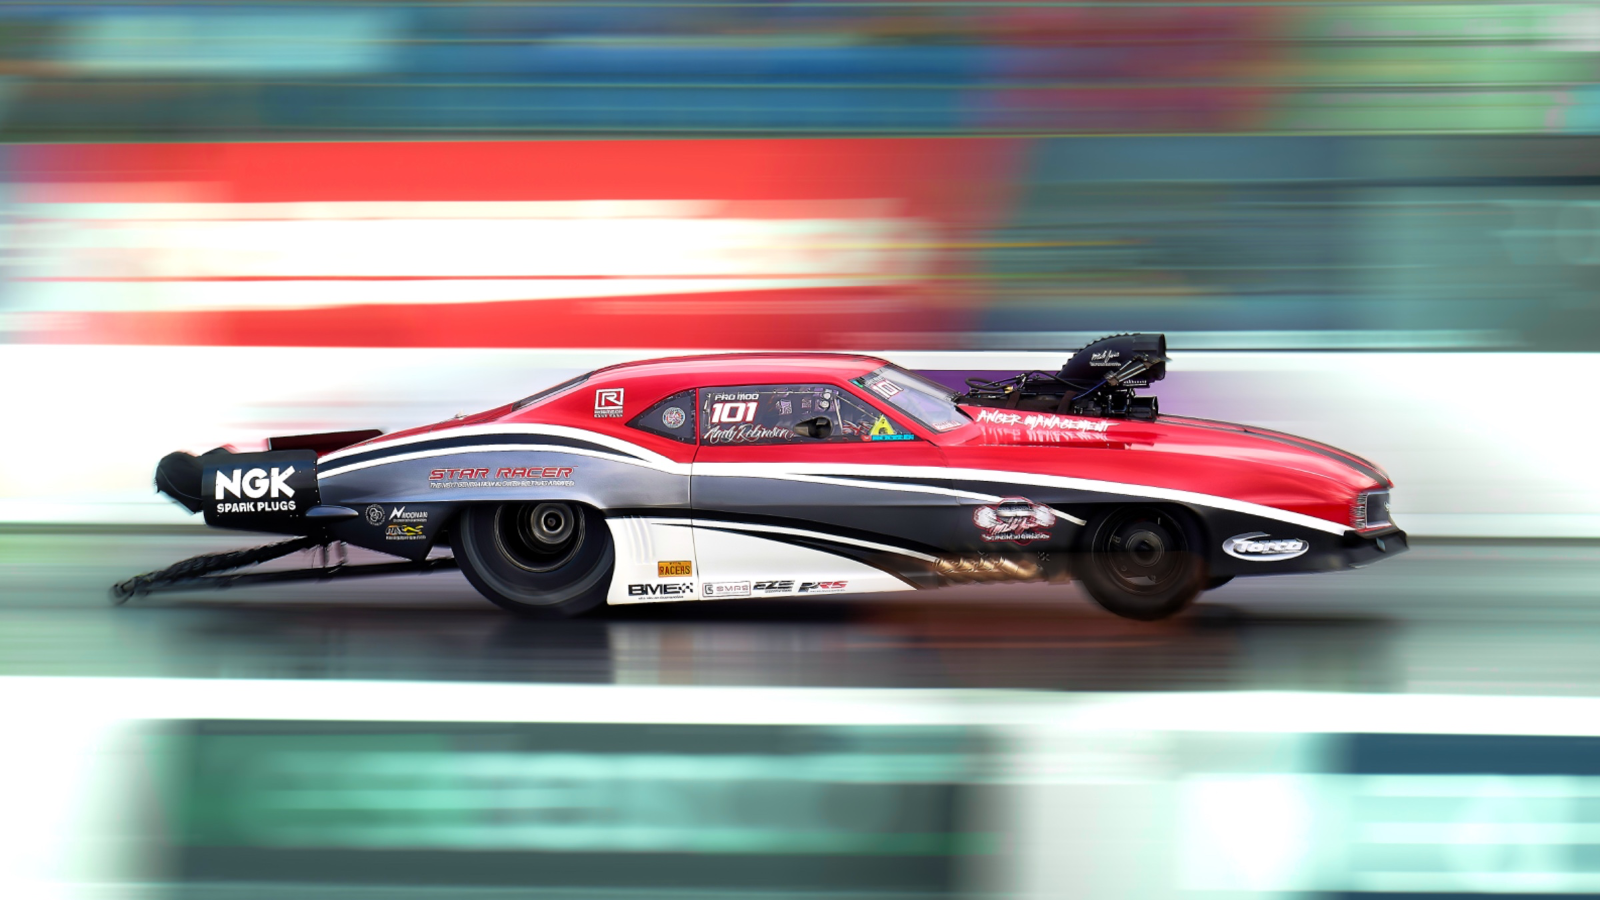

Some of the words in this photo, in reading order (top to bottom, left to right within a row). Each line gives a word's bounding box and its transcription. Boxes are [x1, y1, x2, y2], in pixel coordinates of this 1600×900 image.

[737, 393, 759, 401] MOD
[871, 379, 904, 400] 101
[711, 401, 759, 424] 101
[976, 409, 1022, 425] ANGER
[1024, 414, 1119, 432] MANAGEMENT
[703, 425, 737, 444] Andy
[737, 423, 794, 443] Robinson
[429, 468, 489, 480] STAR
[495, 466, 573, 479] RACER
[215, 465, 296, 500] NGK
[217, 502, 256, 513] SPARK
[257, 500, 296, 512] PLUGS
[1232, 539, 1303, 554] Torco
[660, 565, 691, 575] RACERS
[628, 583, 680, 596] BME
